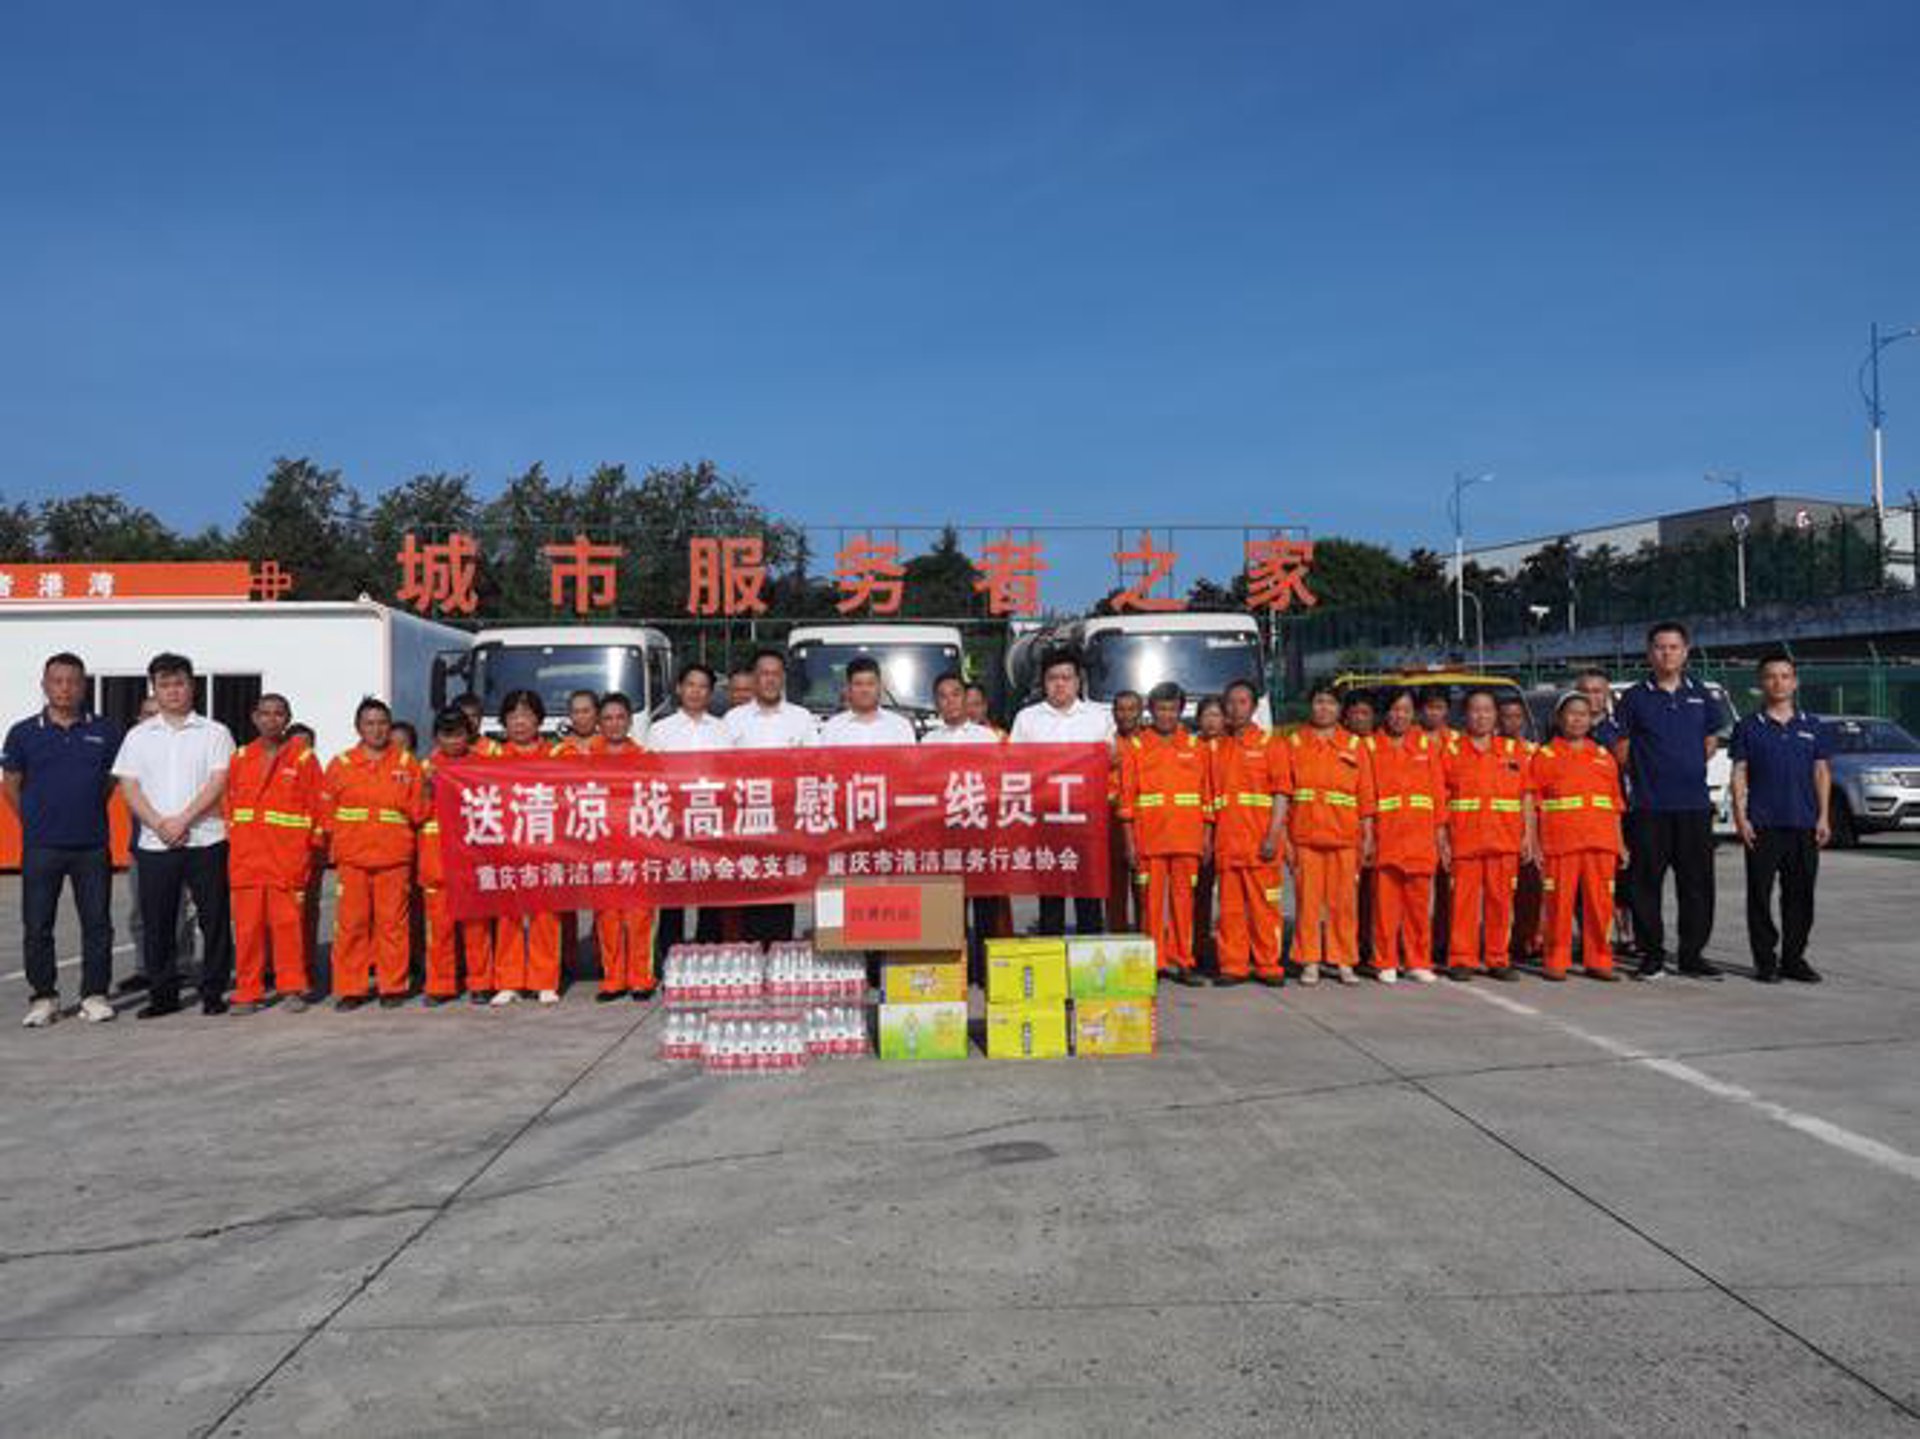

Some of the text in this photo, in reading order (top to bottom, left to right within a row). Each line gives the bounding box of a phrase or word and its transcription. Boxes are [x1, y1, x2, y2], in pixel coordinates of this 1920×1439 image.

[397, 531, 1317, 614] 城市服务者之家
[460, 771, 1087, 845] 送清凉 战高温 慰问一线员工
[828, 847, 1080, 876] 重庆市清洁服务行业协会
